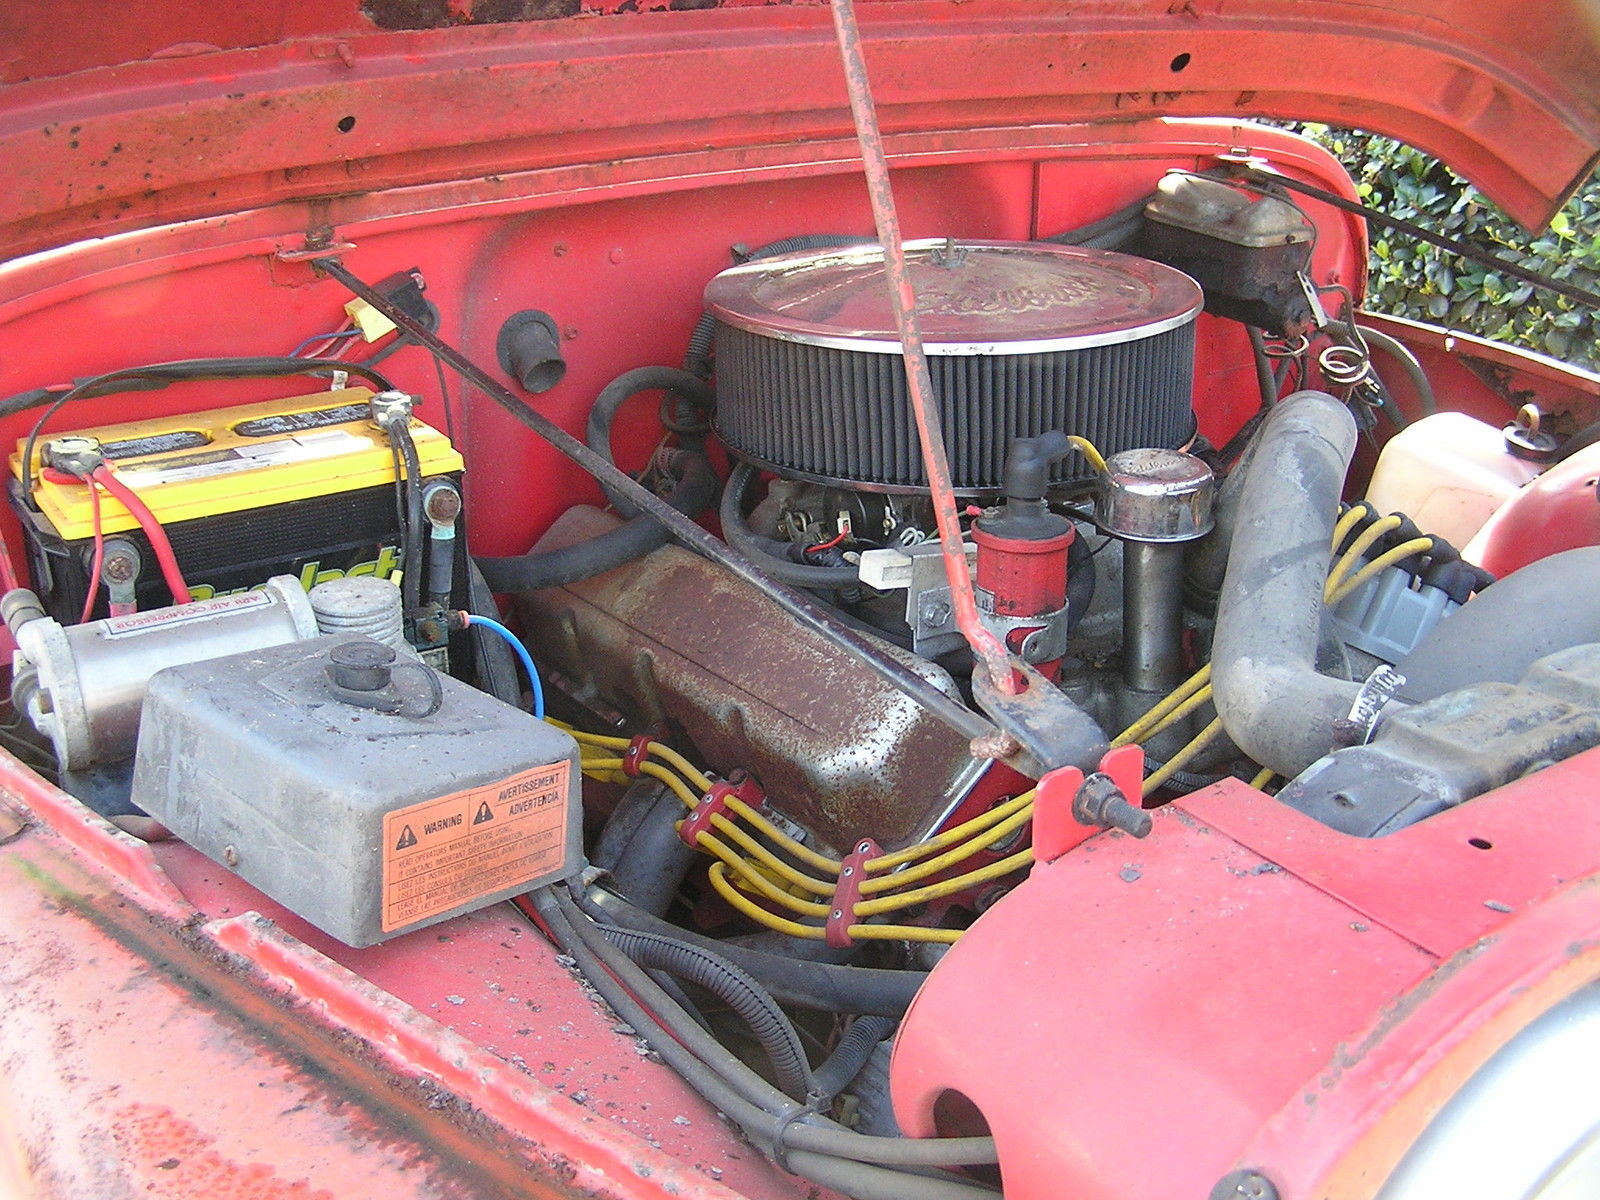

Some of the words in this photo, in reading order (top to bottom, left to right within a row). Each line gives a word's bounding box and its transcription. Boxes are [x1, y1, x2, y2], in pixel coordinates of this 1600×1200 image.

[499, 773, 560, 801] AVERTISSEMENT
[508, 791, 560, 816] ADVERTENCIA
[423, 814, 463, 835] WARNING
